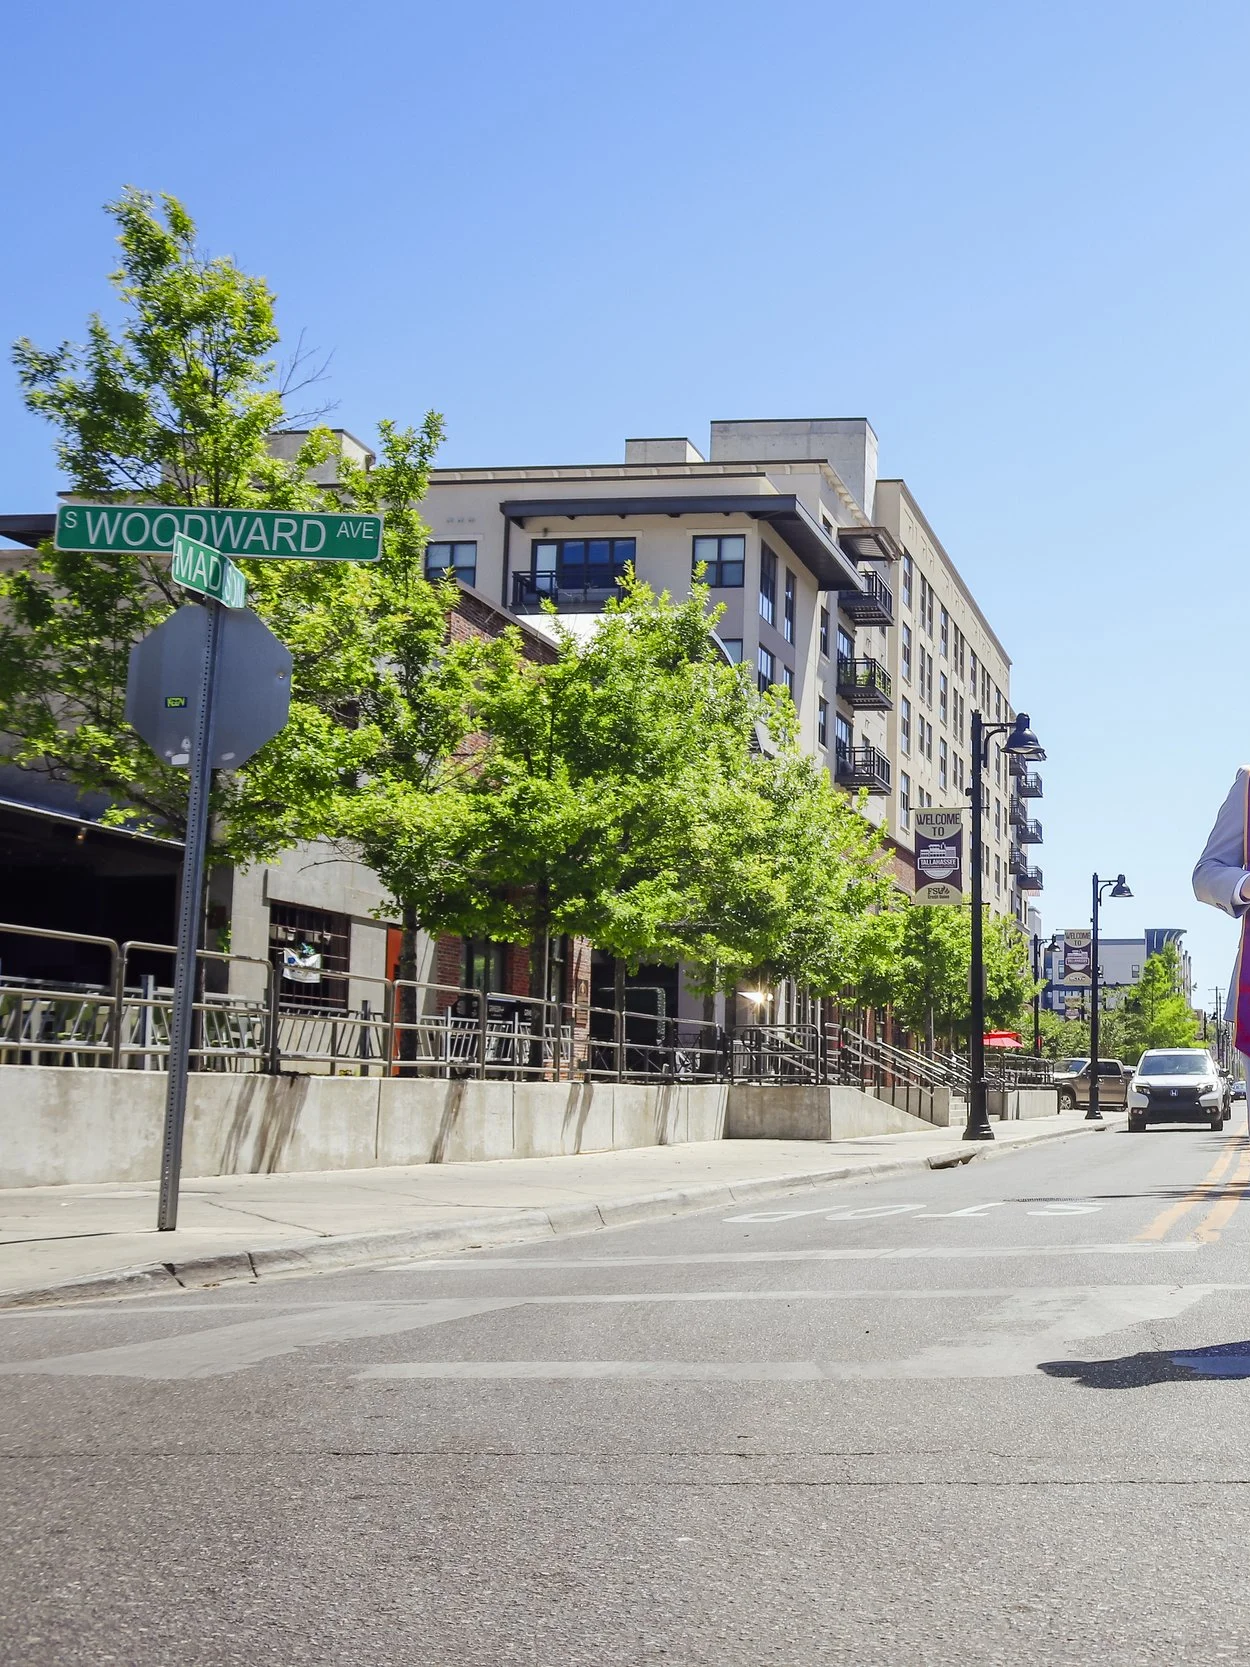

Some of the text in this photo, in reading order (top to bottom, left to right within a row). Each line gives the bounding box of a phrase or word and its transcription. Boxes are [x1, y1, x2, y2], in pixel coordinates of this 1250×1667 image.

[64, 511, 375, 553] S WOODWARD AVE
[916, 813, 960, 825] WELCOME
[931, 826, 945, 836] TO
[1065, 932, 1091, 940] WELCOME
[722, 1202, 1110, 1223] STOP
